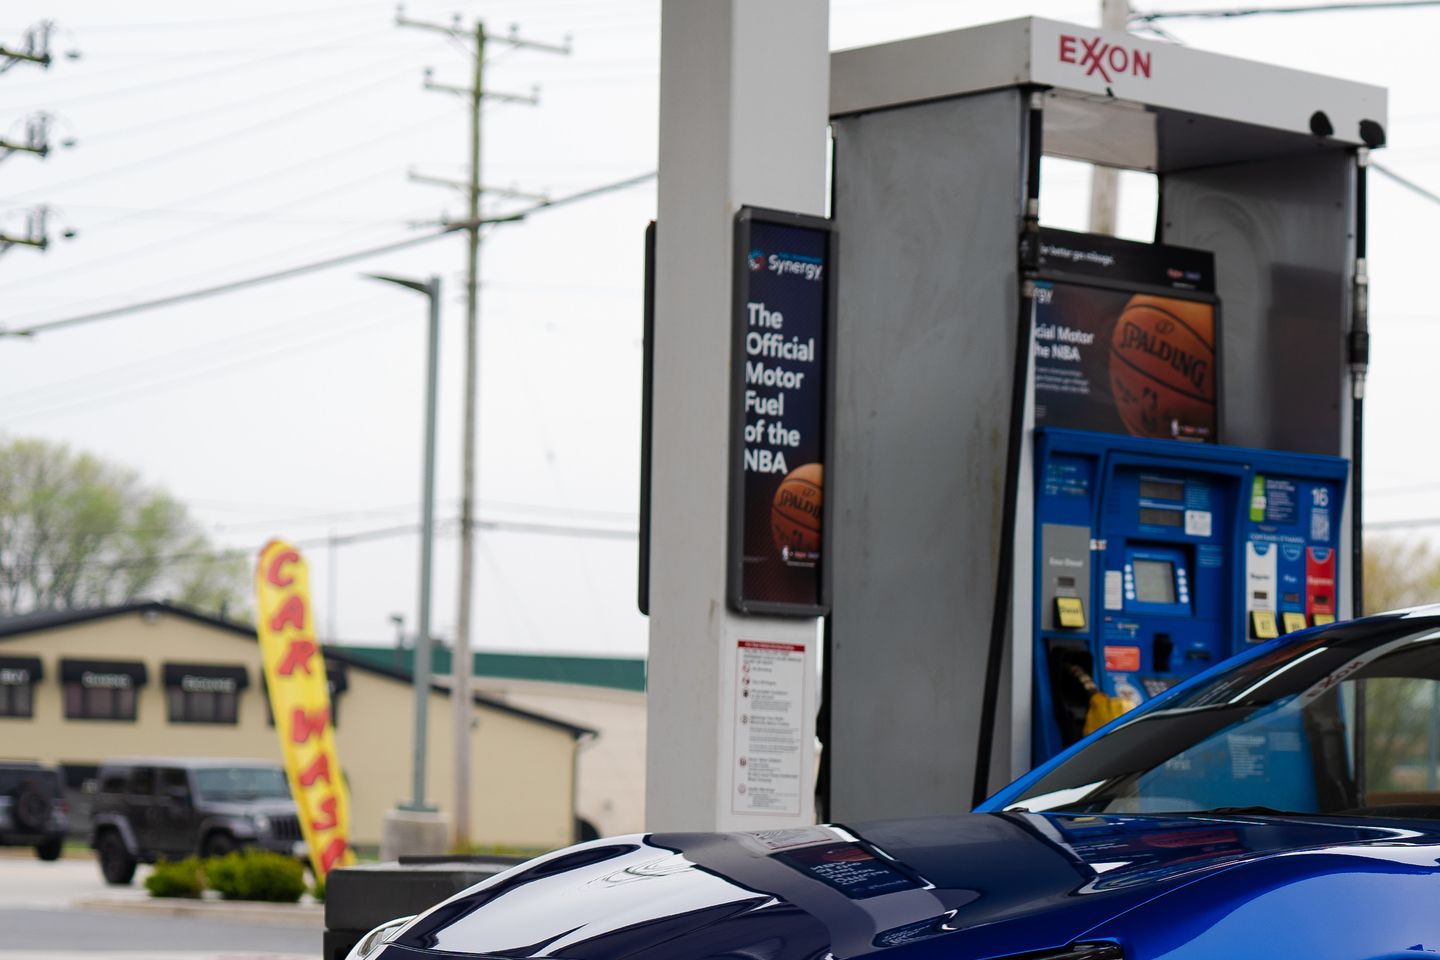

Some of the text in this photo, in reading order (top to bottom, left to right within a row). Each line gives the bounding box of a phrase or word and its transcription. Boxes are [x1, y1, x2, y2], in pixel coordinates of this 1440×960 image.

[1058, 33, 1153, 83] EXXON
[768, 254, 822, 280] Synergy
[747, 302, 783, 329] The
[746, 332, 815, 362] Official
[1057, 326, 1095, 345] Motor
[1052, 344, 1081, 361] NBA
[1119, 321, 1209, 388] SPALDING
[745, 360, 804, 389] Motor
[745, 390, 785, 416] Fuel
[744, 419, 801, 447] of the
[744, 447, 788, 475] NBA
[781, 488, 821, 520] SPALDI
[1311, 487, 1329, 507] 16
[265, 550, 319, 677] CAR
